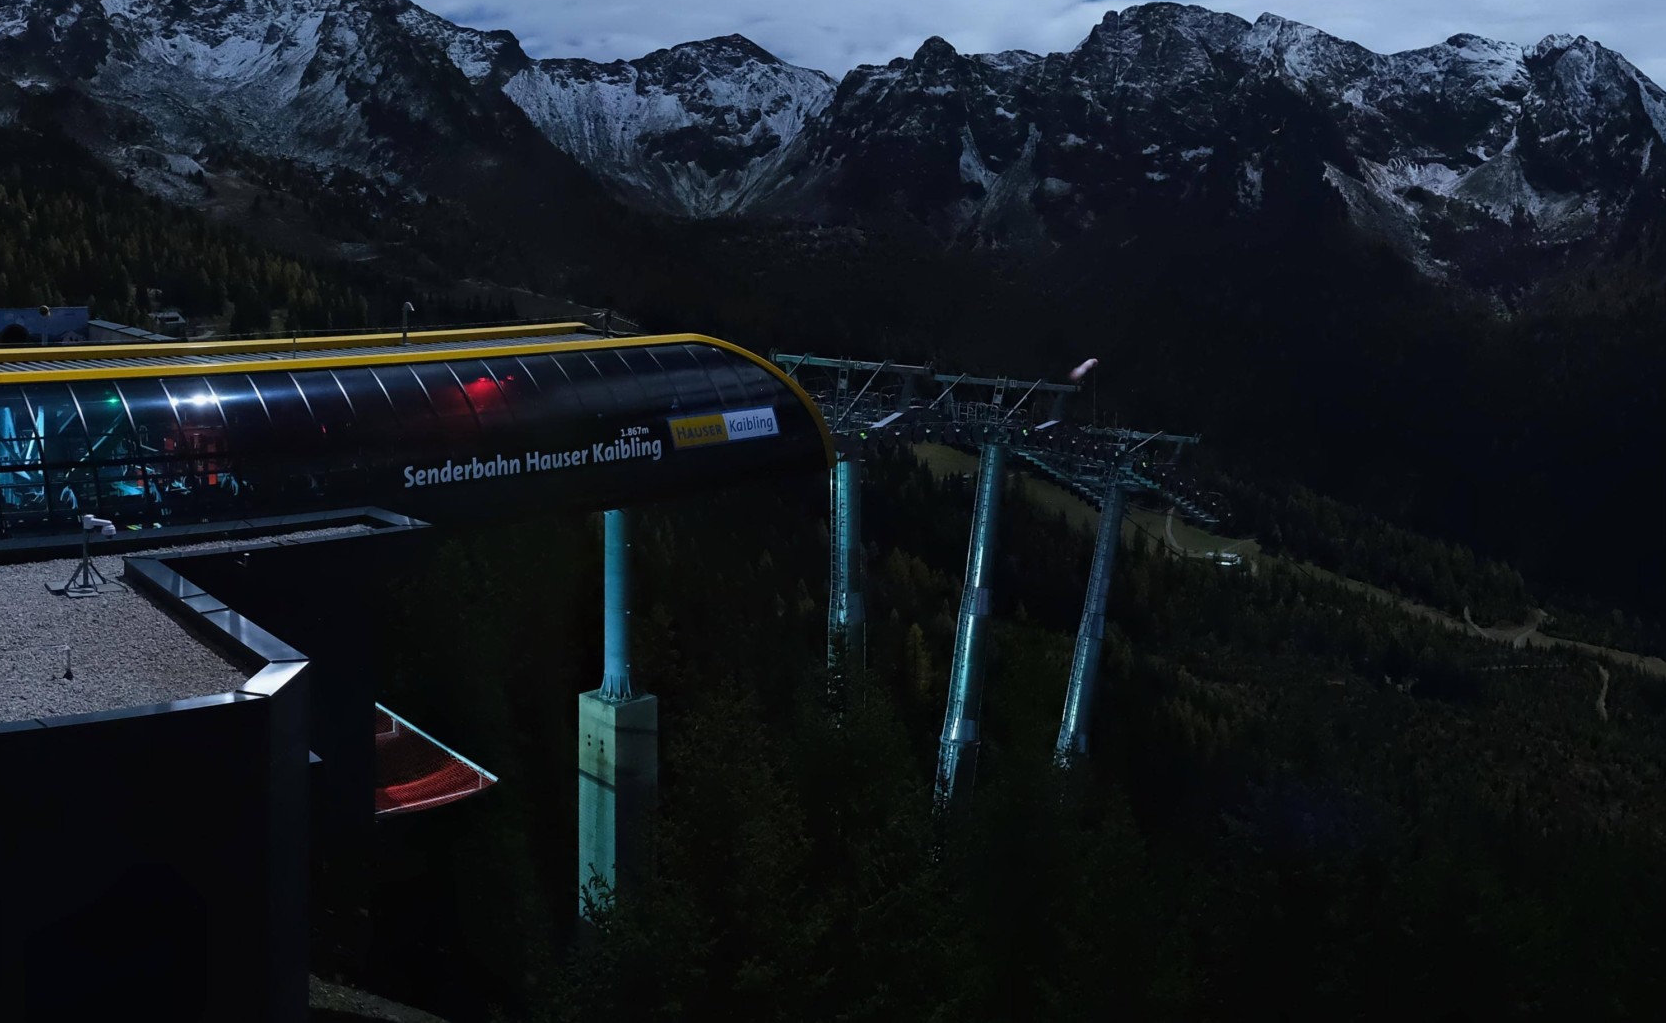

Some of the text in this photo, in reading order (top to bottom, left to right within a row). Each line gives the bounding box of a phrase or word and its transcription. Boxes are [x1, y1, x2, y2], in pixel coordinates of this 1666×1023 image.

[621, 426, 649, 437] 1.867m
[677, 416, 774, 440] HAUSER Kaibling
[403, 437, 662, 488] Senderbahn Hauser Kaibling
